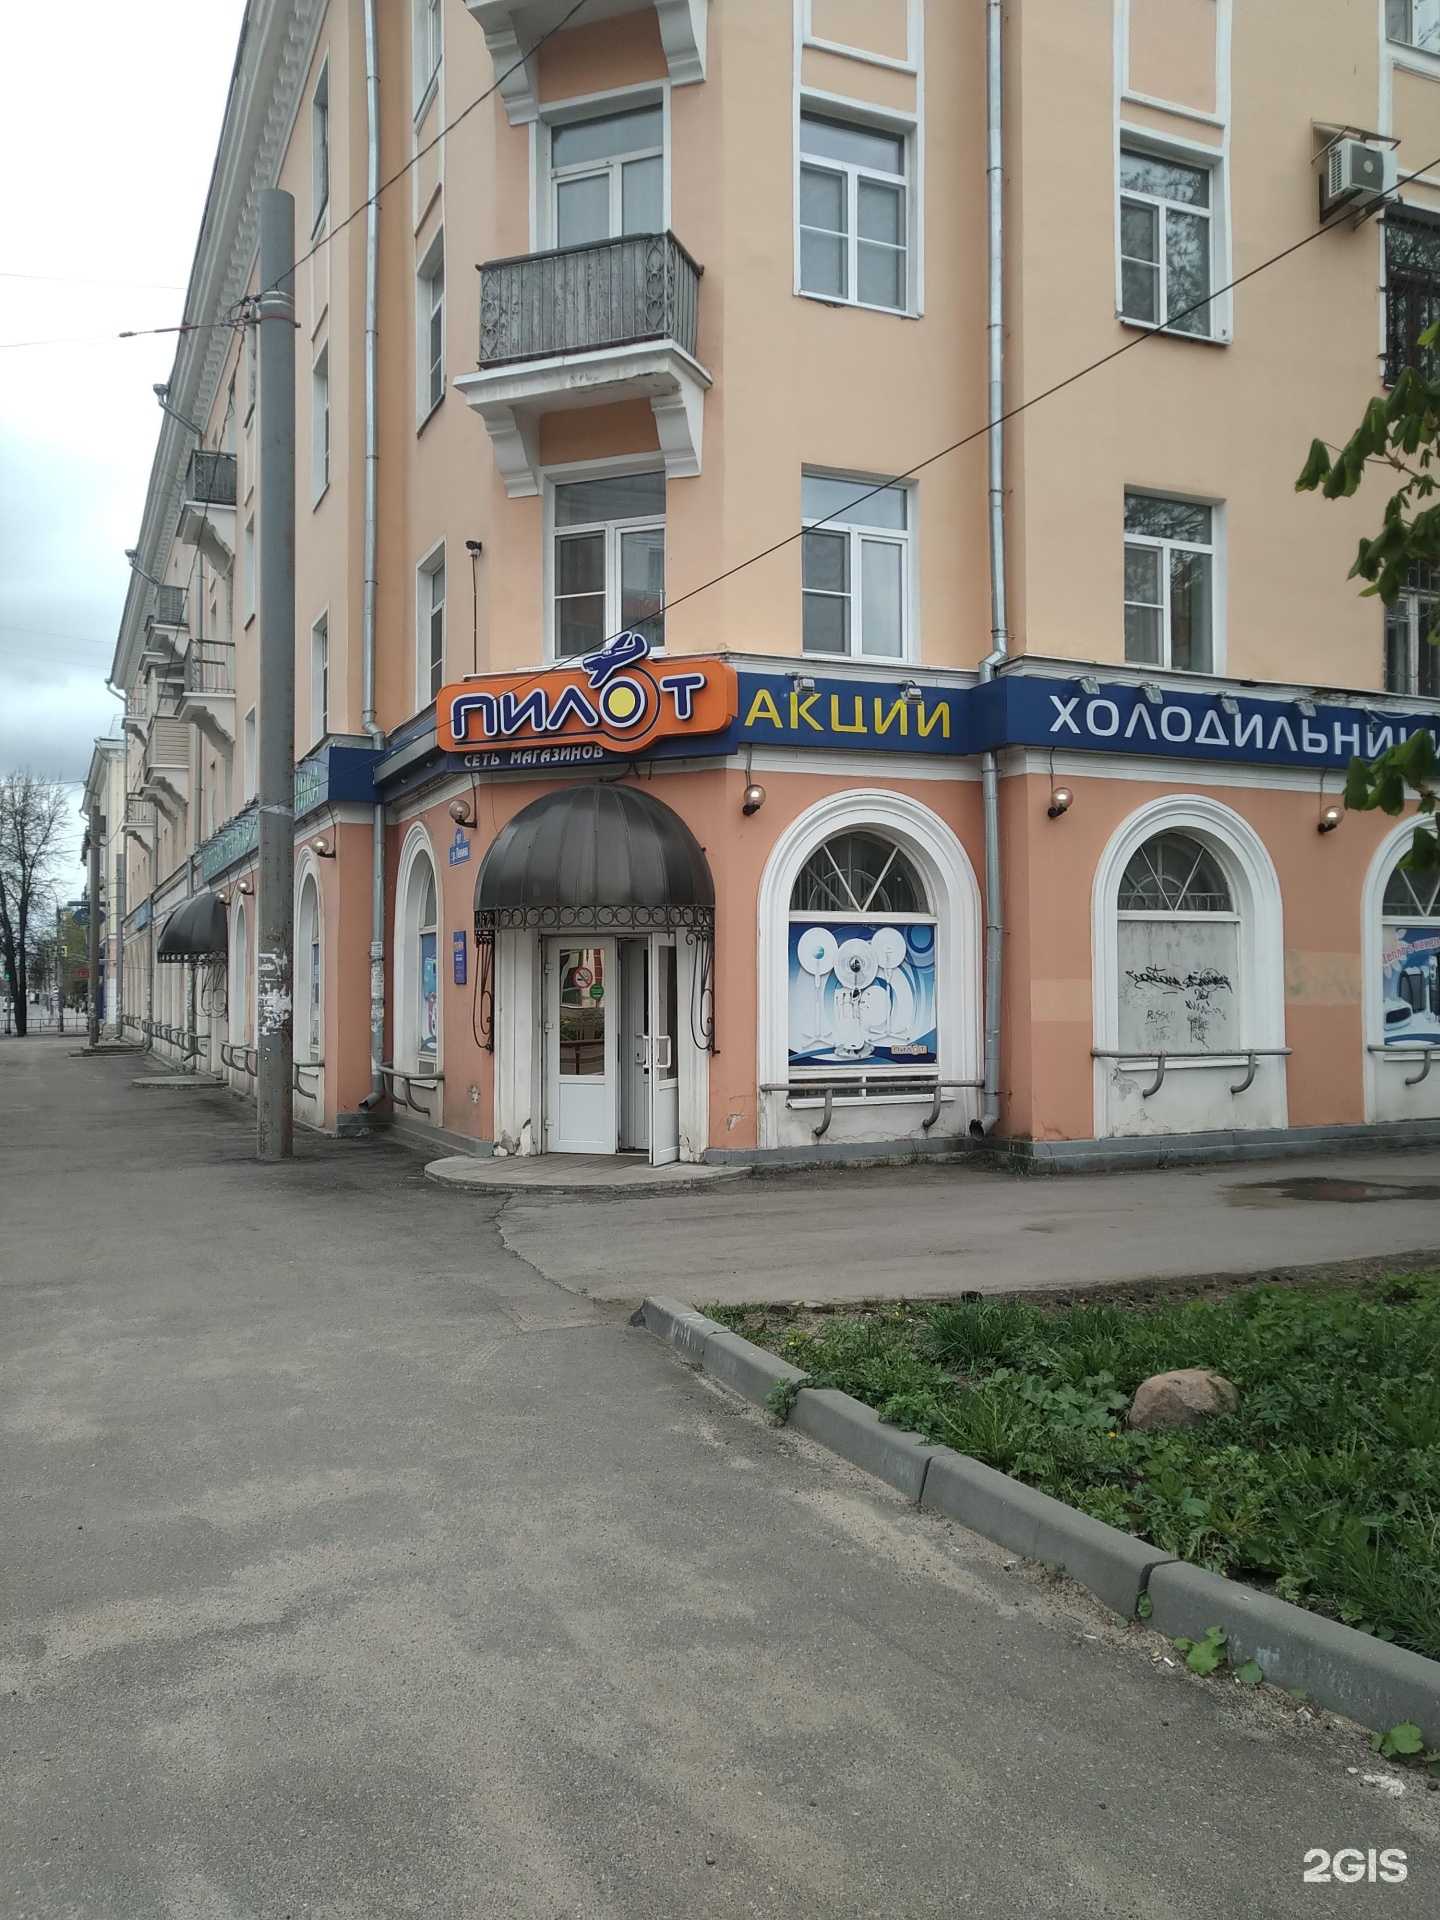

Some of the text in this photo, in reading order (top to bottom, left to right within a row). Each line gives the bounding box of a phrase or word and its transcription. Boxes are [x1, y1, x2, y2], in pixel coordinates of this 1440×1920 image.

[451, 672, 705, 740] ПИЛОТ
[744, 688, 952, 739] АКЦИИ
[1048, 694, 1440, 759] ХОЛОДИЛЬНИ
[464, 745, 604, 767] СЕТЬ МАГАЗИНОВ
